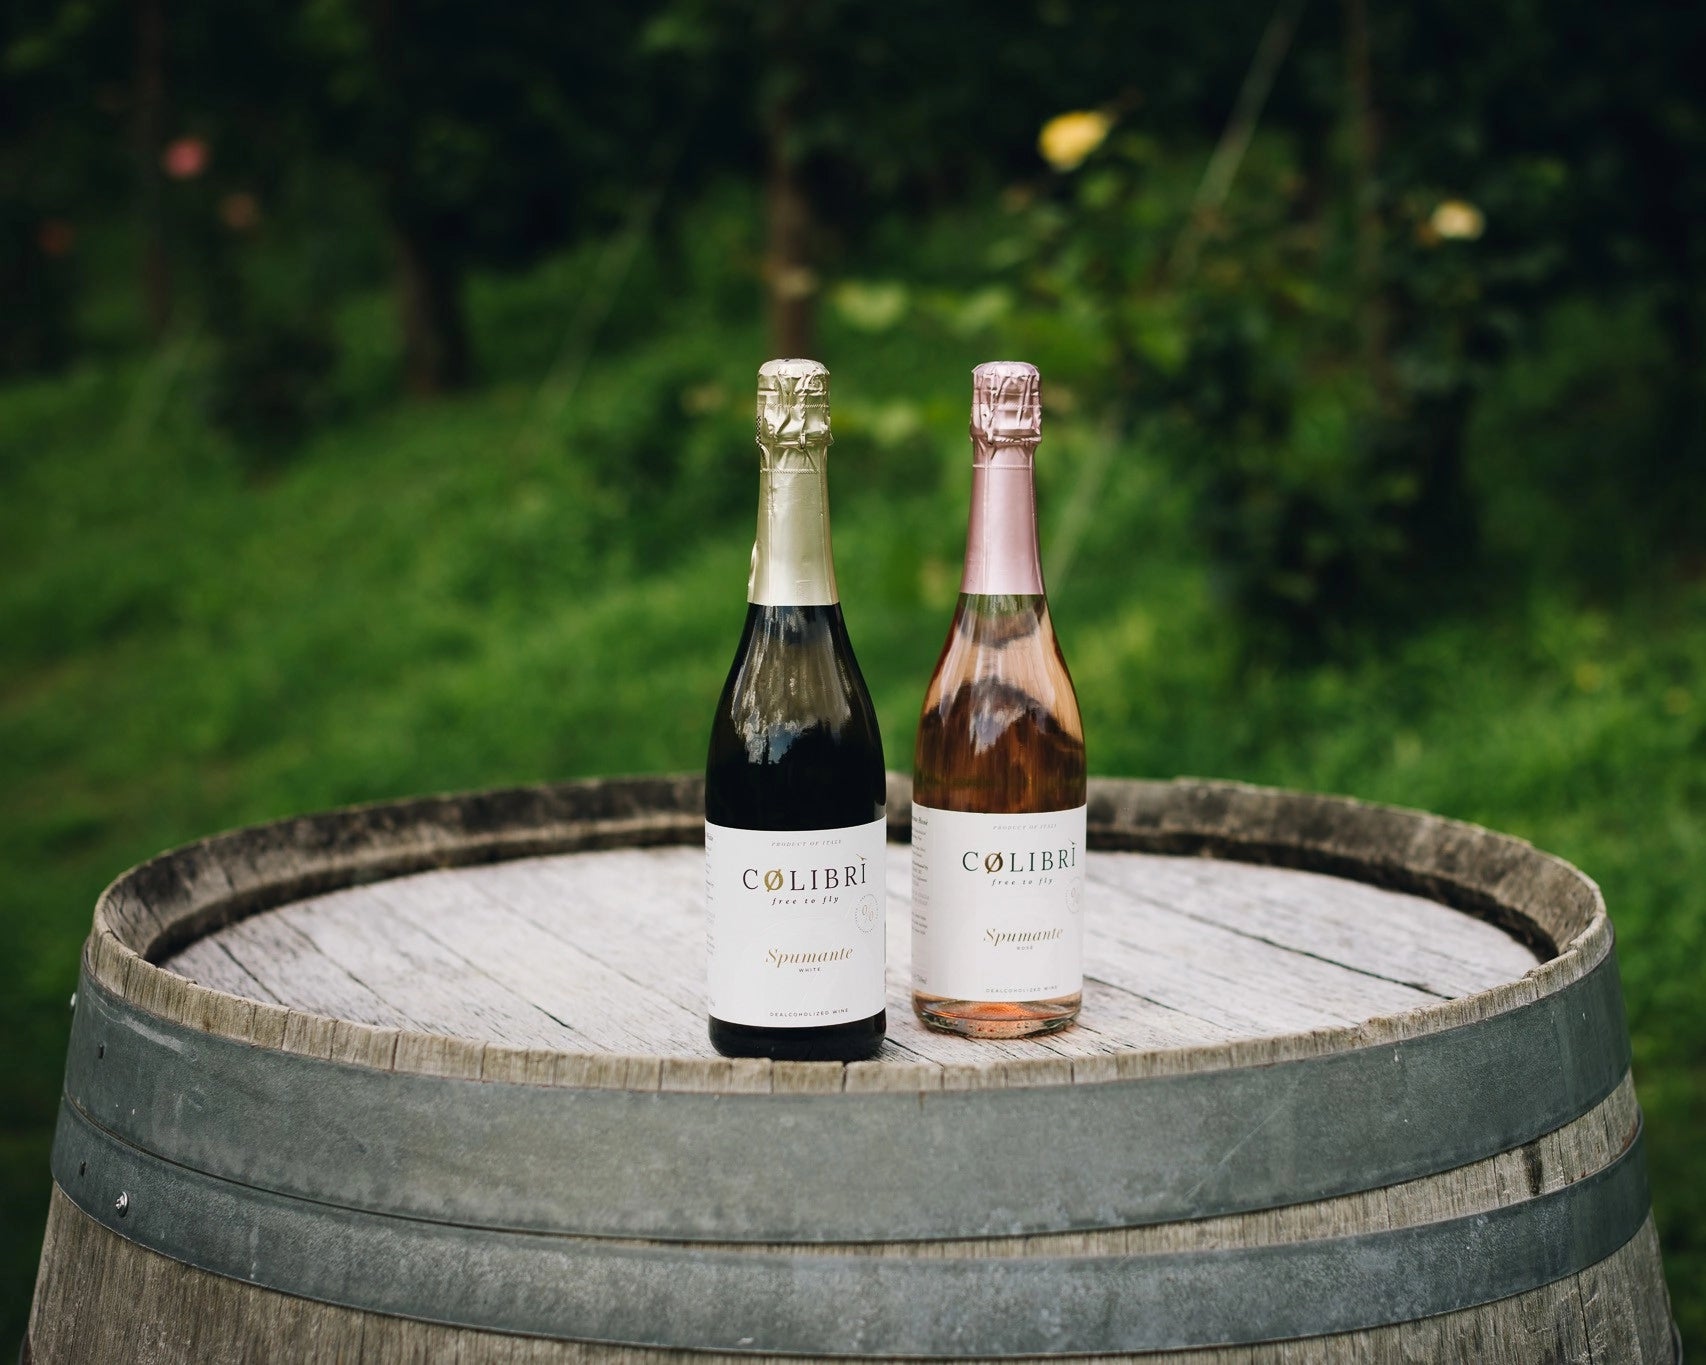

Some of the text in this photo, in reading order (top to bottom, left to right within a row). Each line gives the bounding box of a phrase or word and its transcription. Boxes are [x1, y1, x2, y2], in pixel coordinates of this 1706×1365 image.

[991, 878, 1015, 887] free
[1038, 877, 1053, 886] fly
[771, 897, 797, 906] free
[822, 895, 839, 905] fly
[983, 927, 1063, 947] Spumante
[765, 947, 854, 968] Spumante
[769, 1010, 830, 1018] DEALCOHOLIZED
